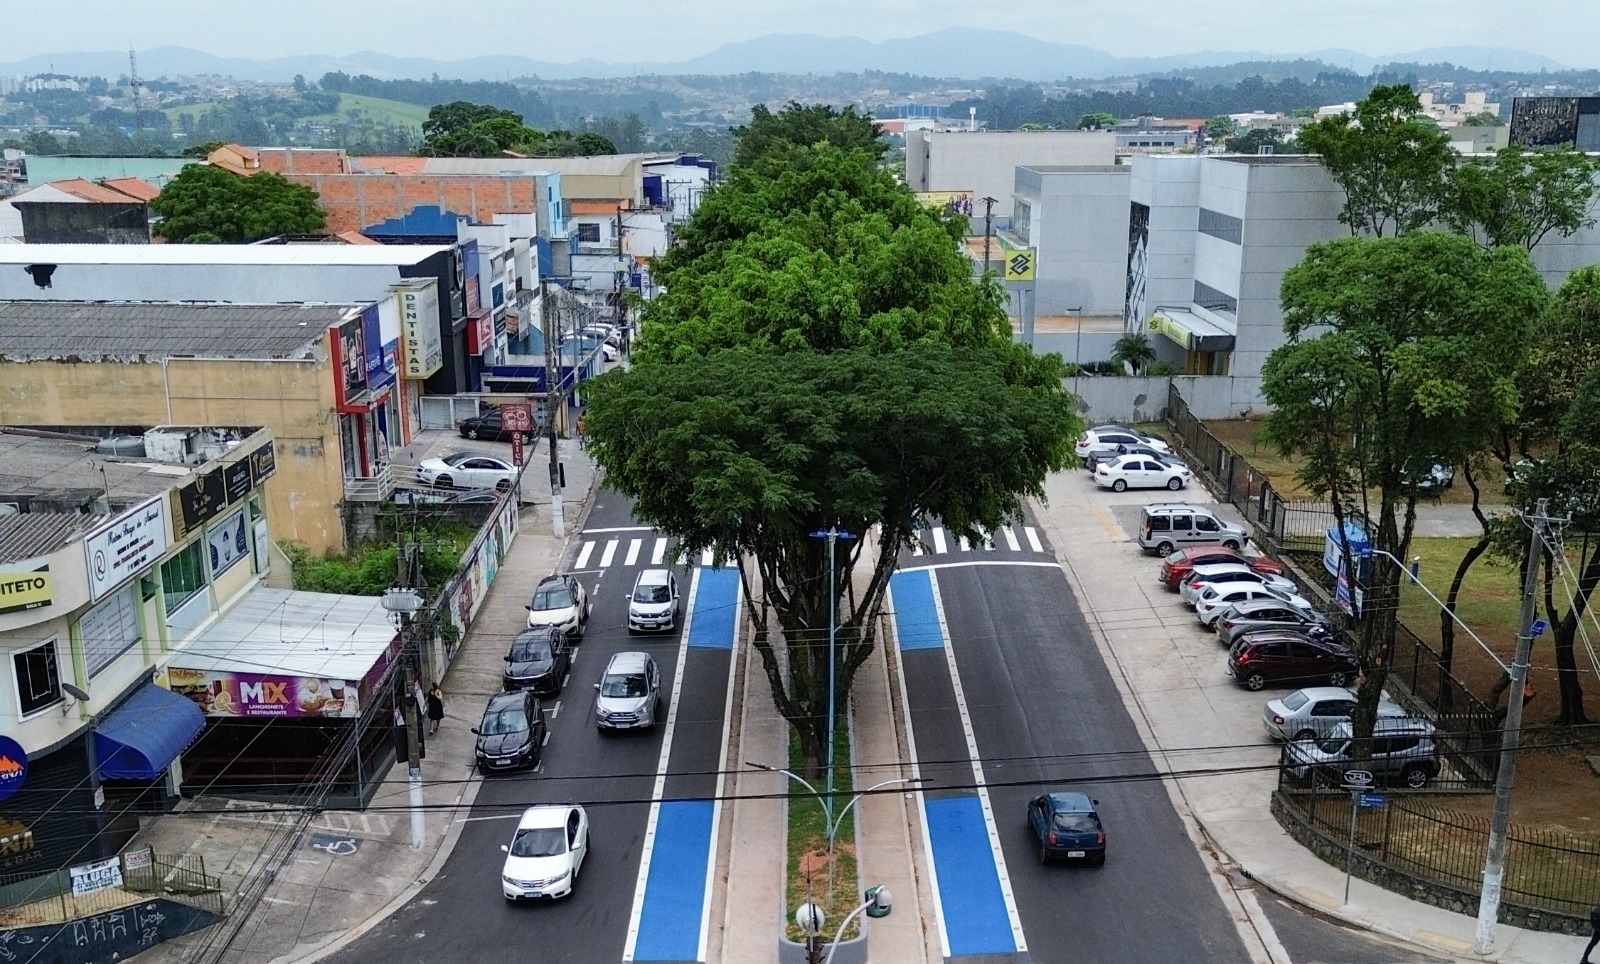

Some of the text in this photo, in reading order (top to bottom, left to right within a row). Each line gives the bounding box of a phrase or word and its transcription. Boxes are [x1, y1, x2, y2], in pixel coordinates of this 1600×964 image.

[405, 294, 420, 373] DENTISTAS
[513, 431, 521, 466] ÓTICA
[0, 577, 45, 595] ITETO
[240, 681, 289, 703] MIX
[73, 866, 121, 886] ALUGA
